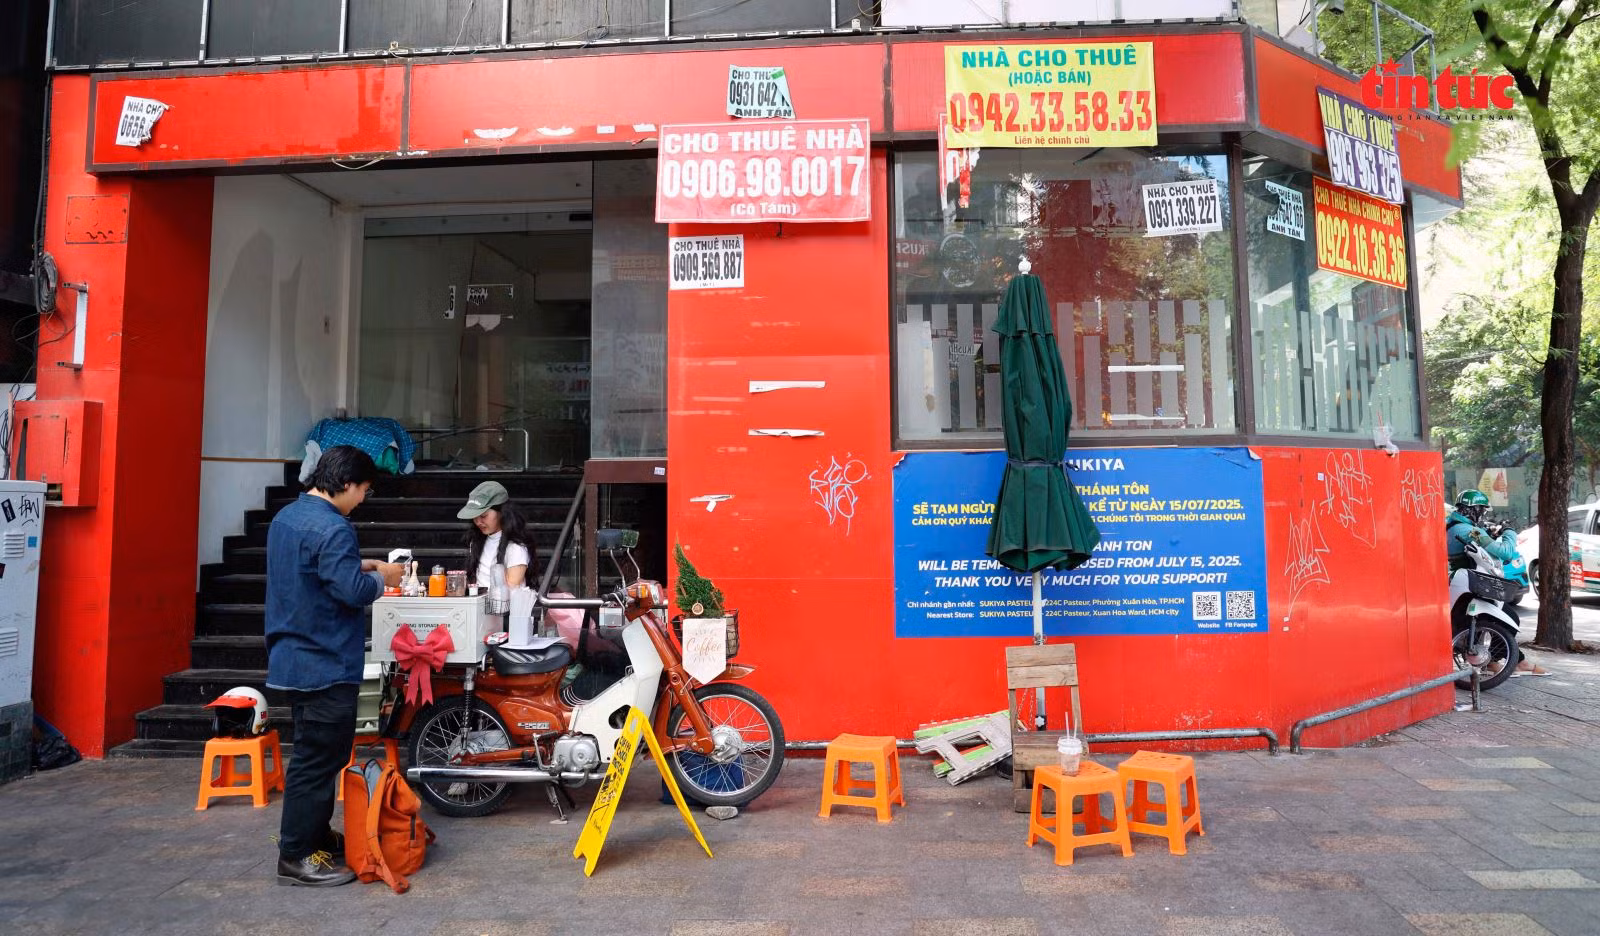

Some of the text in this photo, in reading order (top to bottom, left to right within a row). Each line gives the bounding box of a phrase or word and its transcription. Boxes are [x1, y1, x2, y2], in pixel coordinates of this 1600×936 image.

[962, 44, 1137, 69] NHÀ CHO THUÊ
[732, 69, 772, 81] CHO THU
[1008, 68, 1092, 87] (HOẶC BÁN)
[729, 79, 755, 107] 0931
[757, 81, 778, 107] 642
[127, 99, 144, 113] NHÀ
[735, 107, 762, 117] ANH
[950, 90, 1153, 133] 0942.33.58.33
[1343, 103, 1367, 140] CHO
[664, 124, 865, 154] CHO THUÊ NHÀ
[662, 156, 865, 199] 0906.98.0017
[1147, 181, 1215, 199] NHÀ CHO THUÊ
[730, 202, 756, 216] (Cô
[1148, 194, 1217, 229] 0931.339.227
[1315, 185, 1329, 207] CHO
[1331, 190, 1347, 212] THUÊ
[1348, 195, 1362, 217] NHÀ
[1362, 199, 1381, 222] CHÍNH
[674, 236, 741, 252] CHO THUÊ NHÀ
[1317, 211, 1406, 285] 0922.16.36.36
[674, 251, 742, 281] 0909.569.887
[1075, 481, 1149, 496] THÁNH TÔN
[912, 502, 929, 515] SẼ
[930, 503, 958, 517] TẠM
[1089, 497, 1106, 512] KỂ
[1108, 498, 1128, 512] TỪ
[1130, 499, 1166, 511] NGÀY
[1170, 499, 1244, 511] 15/07/2025.
[912, 515, 932, 526] CẢM
[948, 515, 968, 526] QUÝ
[1097, 513, 1128, 523] CHÚNG
[1129, 513, 1144, 522] TÔI
[1145, 514, 1175, 523] TRONG
[1200, 513, 1223, 522] GIAN
[1223, 513, 1246, 523] QUA!
[1092, 540, 1153, 552] ANH TON
[918, 560, 949, 571] WILL
[951, 559, 969, 571] BE
[1116, 557, 1153, 569] FROM
[1155, 556, 1188, 568] JULY
[1190, 556, 1205, 569] 15,
[1207, 556, 1242, 567] 2025.
[934, 572, 1228, 588] THANK YOU VEY MUCH FOR YOUR SUPPORT!
[1063, 599, 1091, 607] Pasteur,
[954, 611, 975, 619] Store:
[1063, 609, 1091, 617] Pasteur,
[1092, 609, 1111, 617] Xuan
[1127, 608, 1147, 617] Ward,
[1148, 608, 1165, 616] HCM
[1165, 608, 1180, 617] city
[1197, 621, 1221, 629] Website
[1233, 621, 1257, 630] Fanpage
